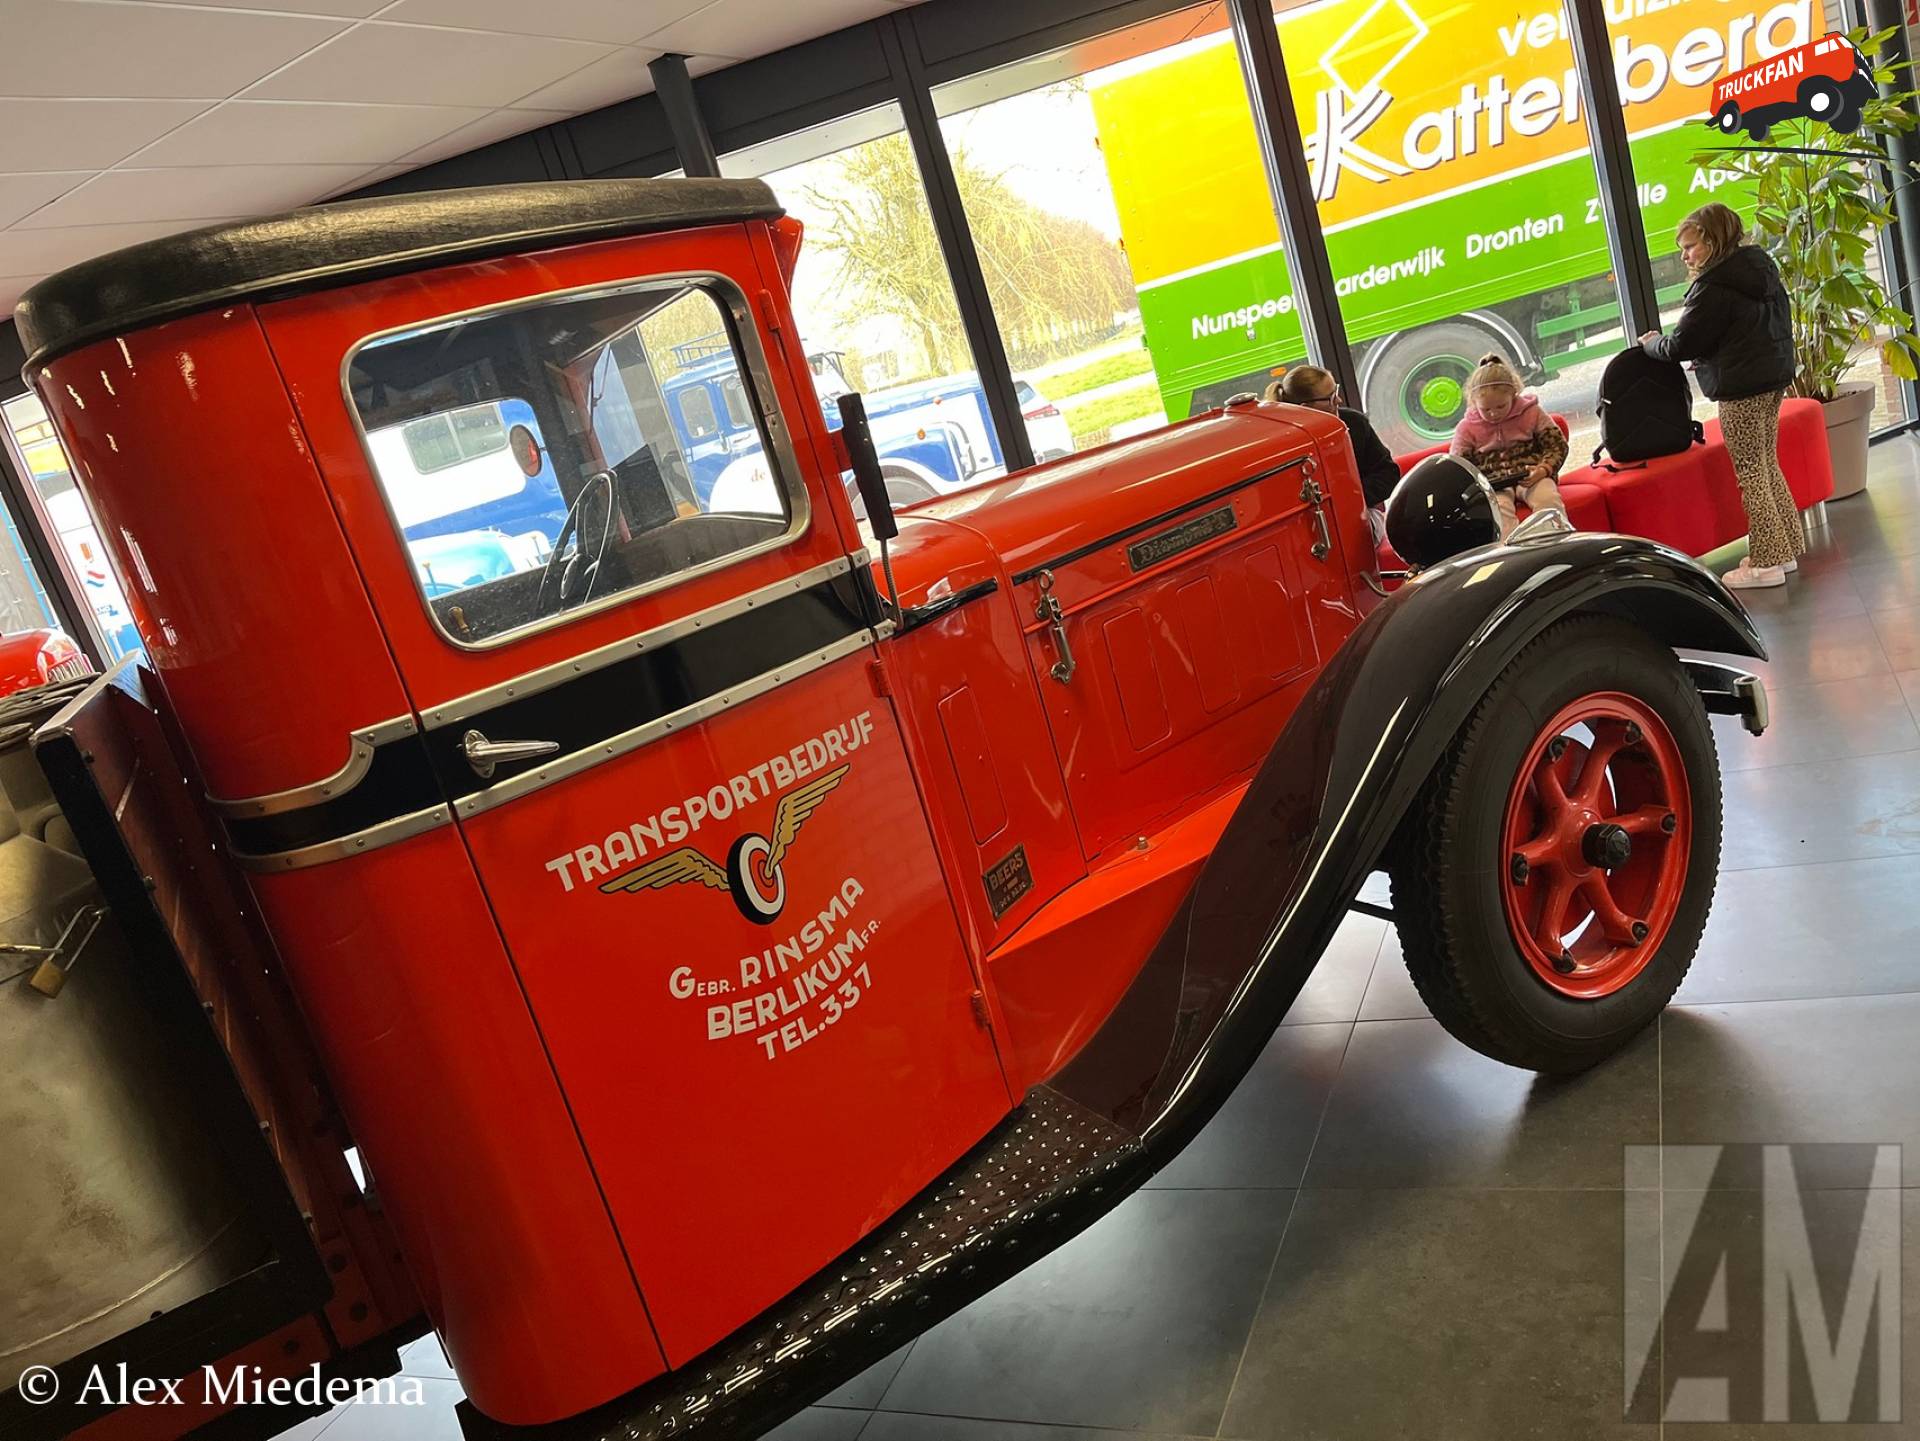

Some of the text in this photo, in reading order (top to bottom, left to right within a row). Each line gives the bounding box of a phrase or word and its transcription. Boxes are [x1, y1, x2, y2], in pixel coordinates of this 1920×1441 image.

[1335, 246, 1446, 298] arderwijk
[1466, 213, 1564, 259] Dronten
[545, 711, 874, 892] TRANSPORTBEDRIJF
[989, 852, 1024, 891] BEERS
[708, 929, 866, 1040] BERLIKUM
[739, 877, 864, 988] RINSMA
